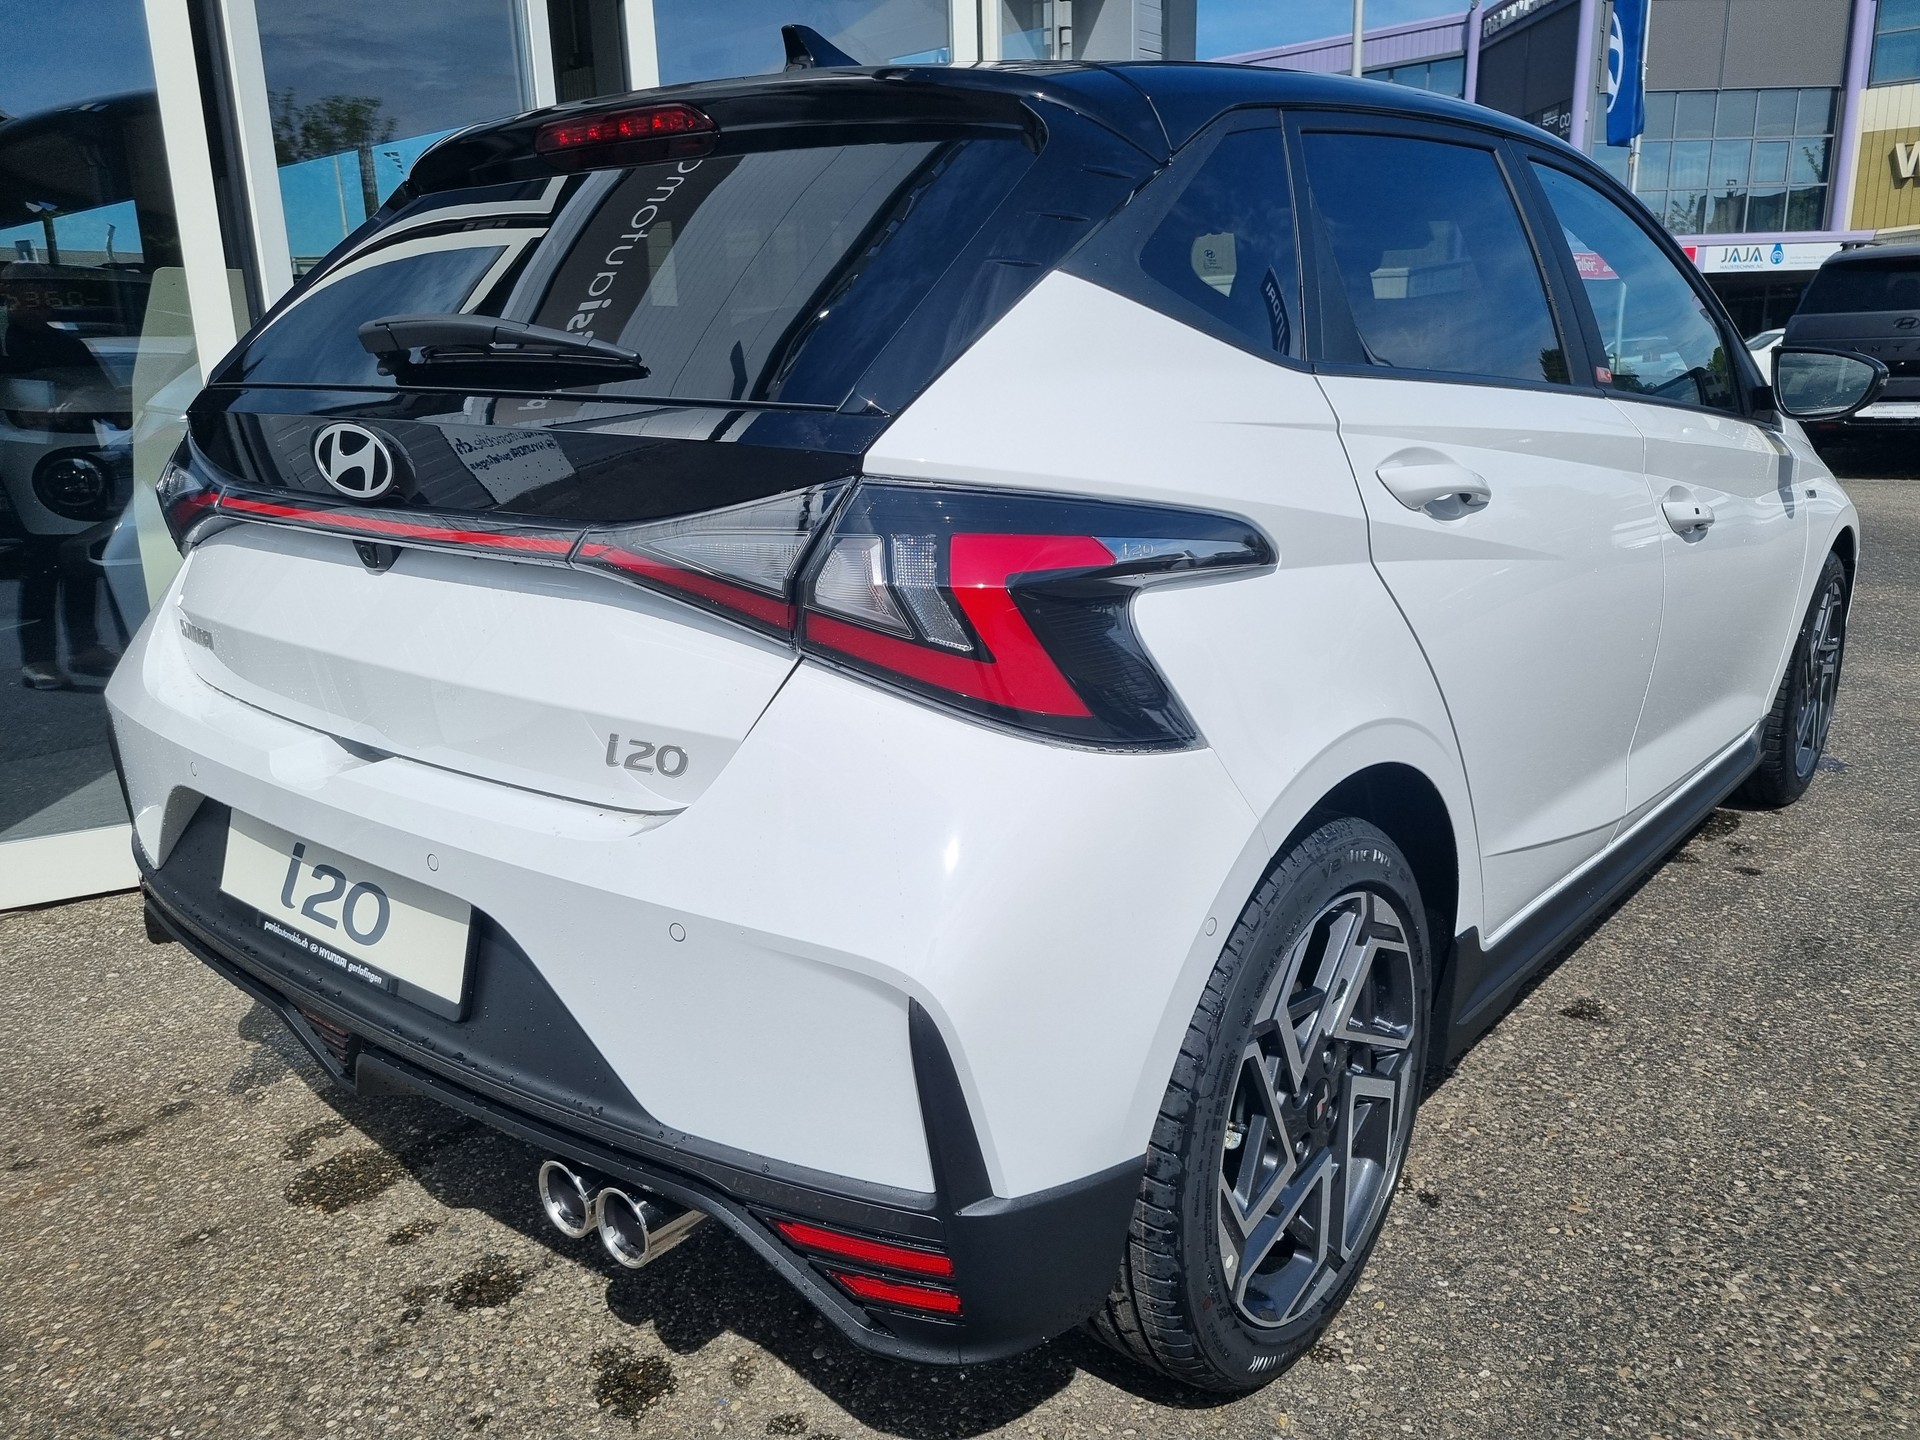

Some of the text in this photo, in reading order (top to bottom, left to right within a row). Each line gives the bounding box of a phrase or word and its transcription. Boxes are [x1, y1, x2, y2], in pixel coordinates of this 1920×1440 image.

[1721, 247, 1763, 263] JAJA
[605, 733, 689, 779] i20
[280, 841, 391, 946] i20
[318, 946, 348, 968] HYUNDAI
